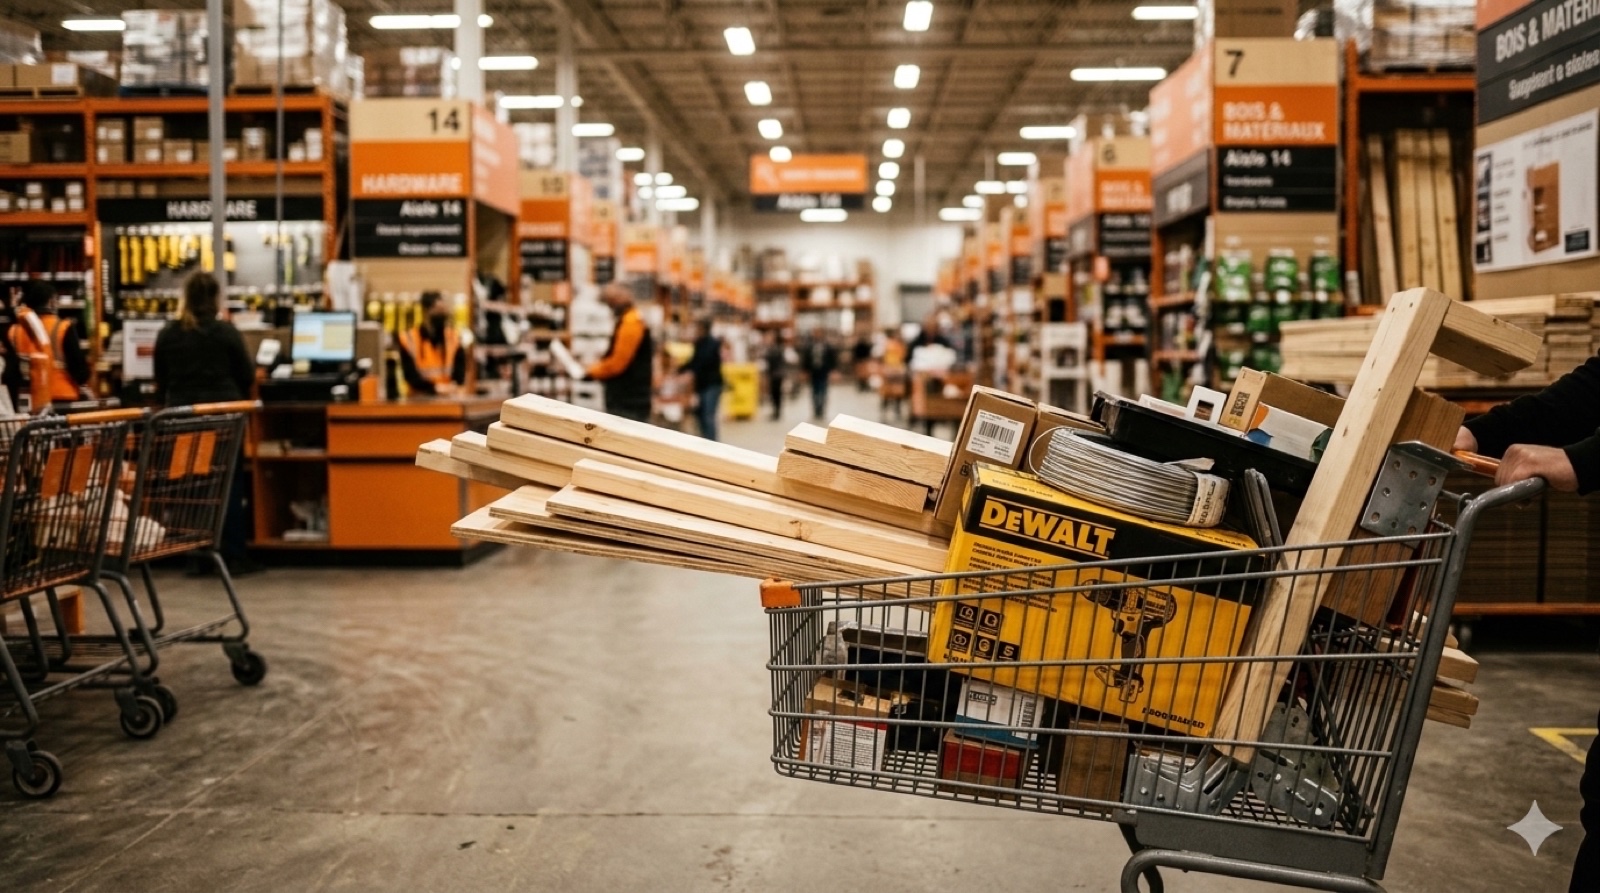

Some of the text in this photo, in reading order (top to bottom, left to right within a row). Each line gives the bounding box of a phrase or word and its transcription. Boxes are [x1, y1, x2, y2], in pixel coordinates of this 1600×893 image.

[1496, 22, 1527, 62] BOIS
[1527, 17, 1539, 47] &
[1225, 49, 1245, 78] 7
[428, 107, 461, 132] 14
[1223, 101, 1266, 121] BOIS
[1271, 150, 1292, 166] 14
[361, 173, 463, 194] HARDWARE
[166, 201, 257, 219] HARDARE
